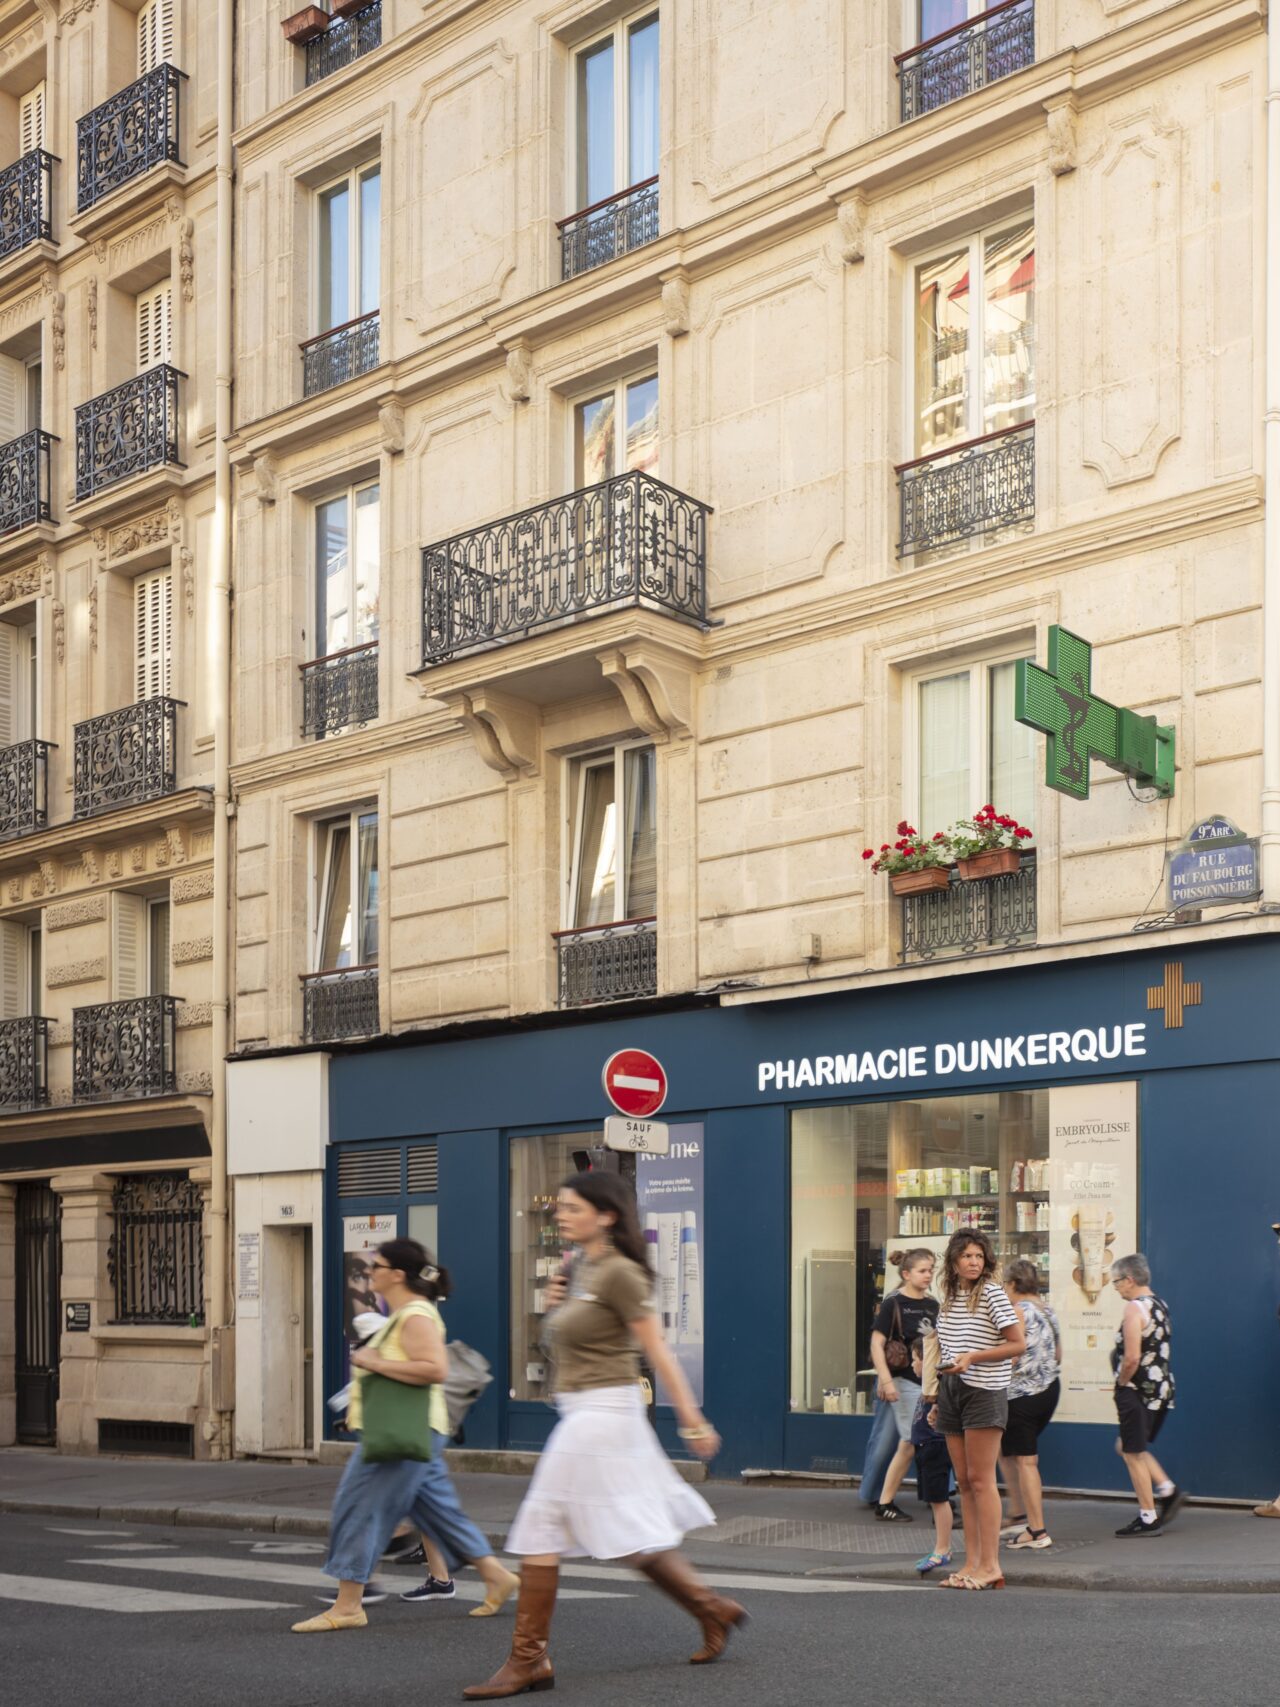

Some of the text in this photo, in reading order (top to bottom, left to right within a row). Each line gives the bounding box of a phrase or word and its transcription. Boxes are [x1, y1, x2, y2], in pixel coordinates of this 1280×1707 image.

[1199, 853, 1226, 867] RUE
[1173, 864, 1252, 886] DU FAUBOURG
[1172, 878, 1253, 900] POISSONNIÈRE
[758, 1023, 1147, 1091] PHARMACIE DUNKERQUE
[626, 1122, 652, 1133] SAUF
[1055, 1122, 1130, 1137] EMBRYOLISSE
[281, 1206, 293, 1216] 163
